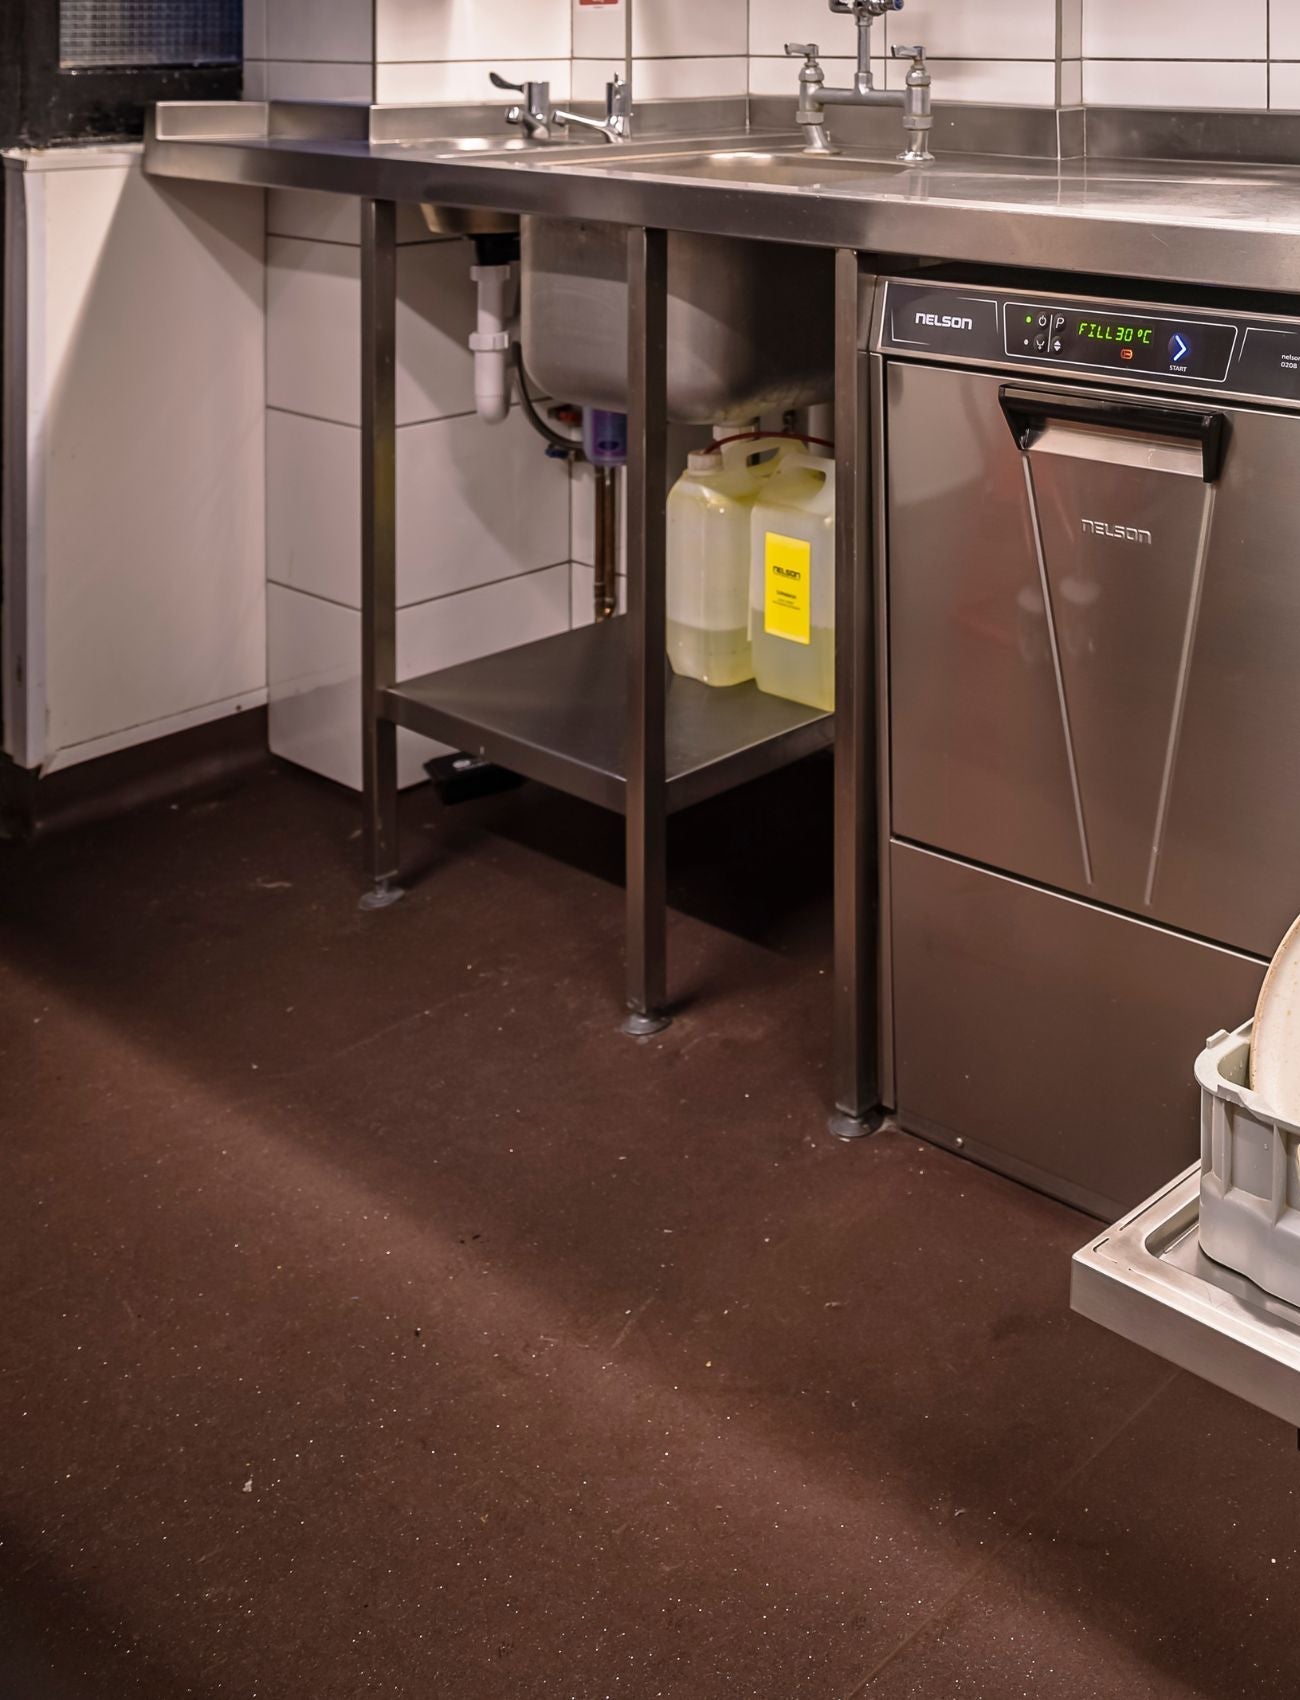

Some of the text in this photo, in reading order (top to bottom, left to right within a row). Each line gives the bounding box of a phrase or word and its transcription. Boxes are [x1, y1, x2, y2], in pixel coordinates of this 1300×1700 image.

[915, 312, 973, 330] NELSON
[1055, 317, 1065, 329] P
[1169, 364, 1187, 372] START
[1280, 361, 1297, 369] 0208
[1081, 519, 1152, 544] NELSON
